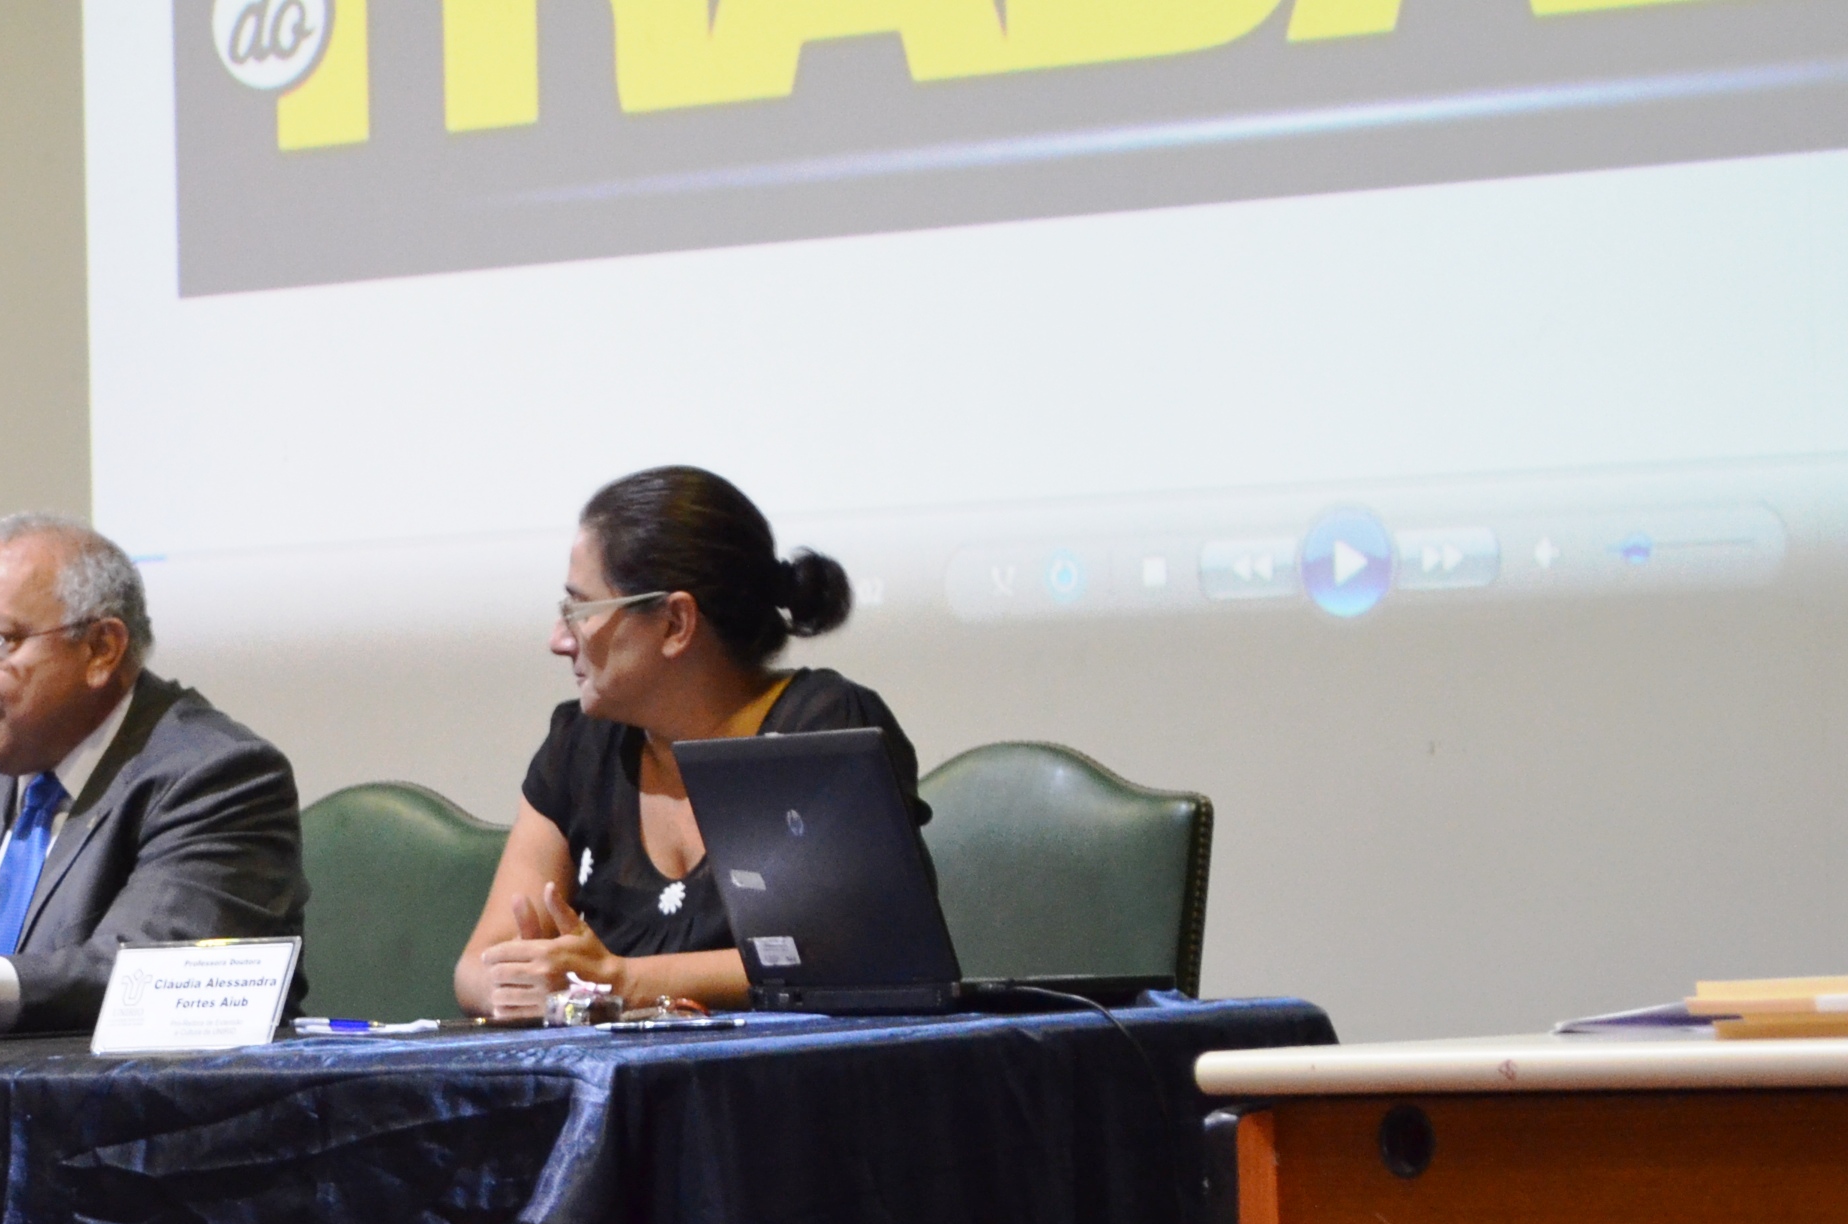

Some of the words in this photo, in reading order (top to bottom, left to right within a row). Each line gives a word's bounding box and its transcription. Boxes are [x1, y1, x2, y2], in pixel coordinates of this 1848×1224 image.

[205, 976, 277, 989] Alessandra
[176, 999, 215, 1009] Fortes
[220, 997, 249, 1007] Aiub
